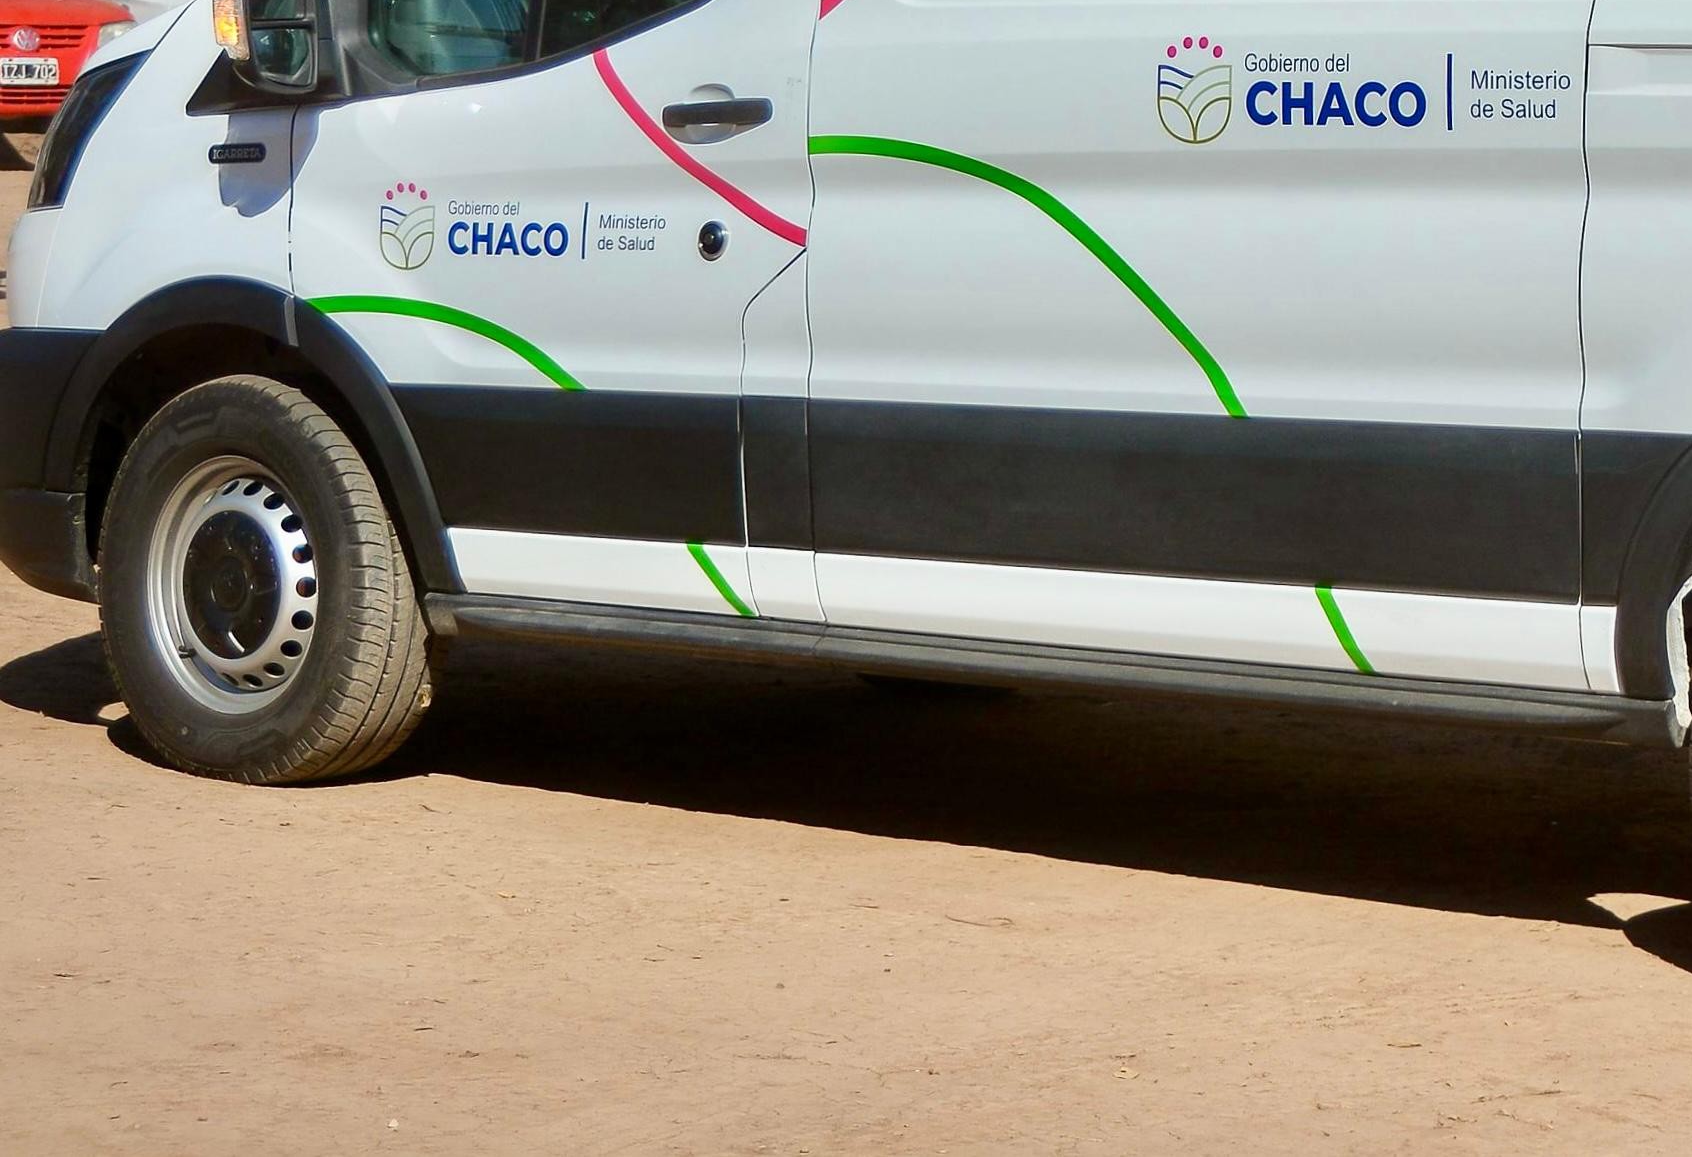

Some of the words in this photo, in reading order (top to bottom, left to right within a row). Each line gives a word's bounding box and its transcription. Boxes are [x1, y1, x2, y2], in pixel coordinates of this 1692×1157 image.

[32, 64, 56, 78] 702
[1244, 53, 1320, 72] Gobierno
[1325, 53, 1349, 72] del
[1470, 70, 1570, 90] Ministerio
[1246, 81, 1427, 127] CHACO
[1470, 98, 1494, 119] de
[1500, 98, 1556, 119] Salud
[448, 200, 499, 215] Gobierno
[502, 201, 519, 215] del
[599, 214, 666, 230] Ministerio
[448, 221, 568, 256] CHACO
[597, 236, 613, 251] de
[618, 236, 655, 251] Salud
